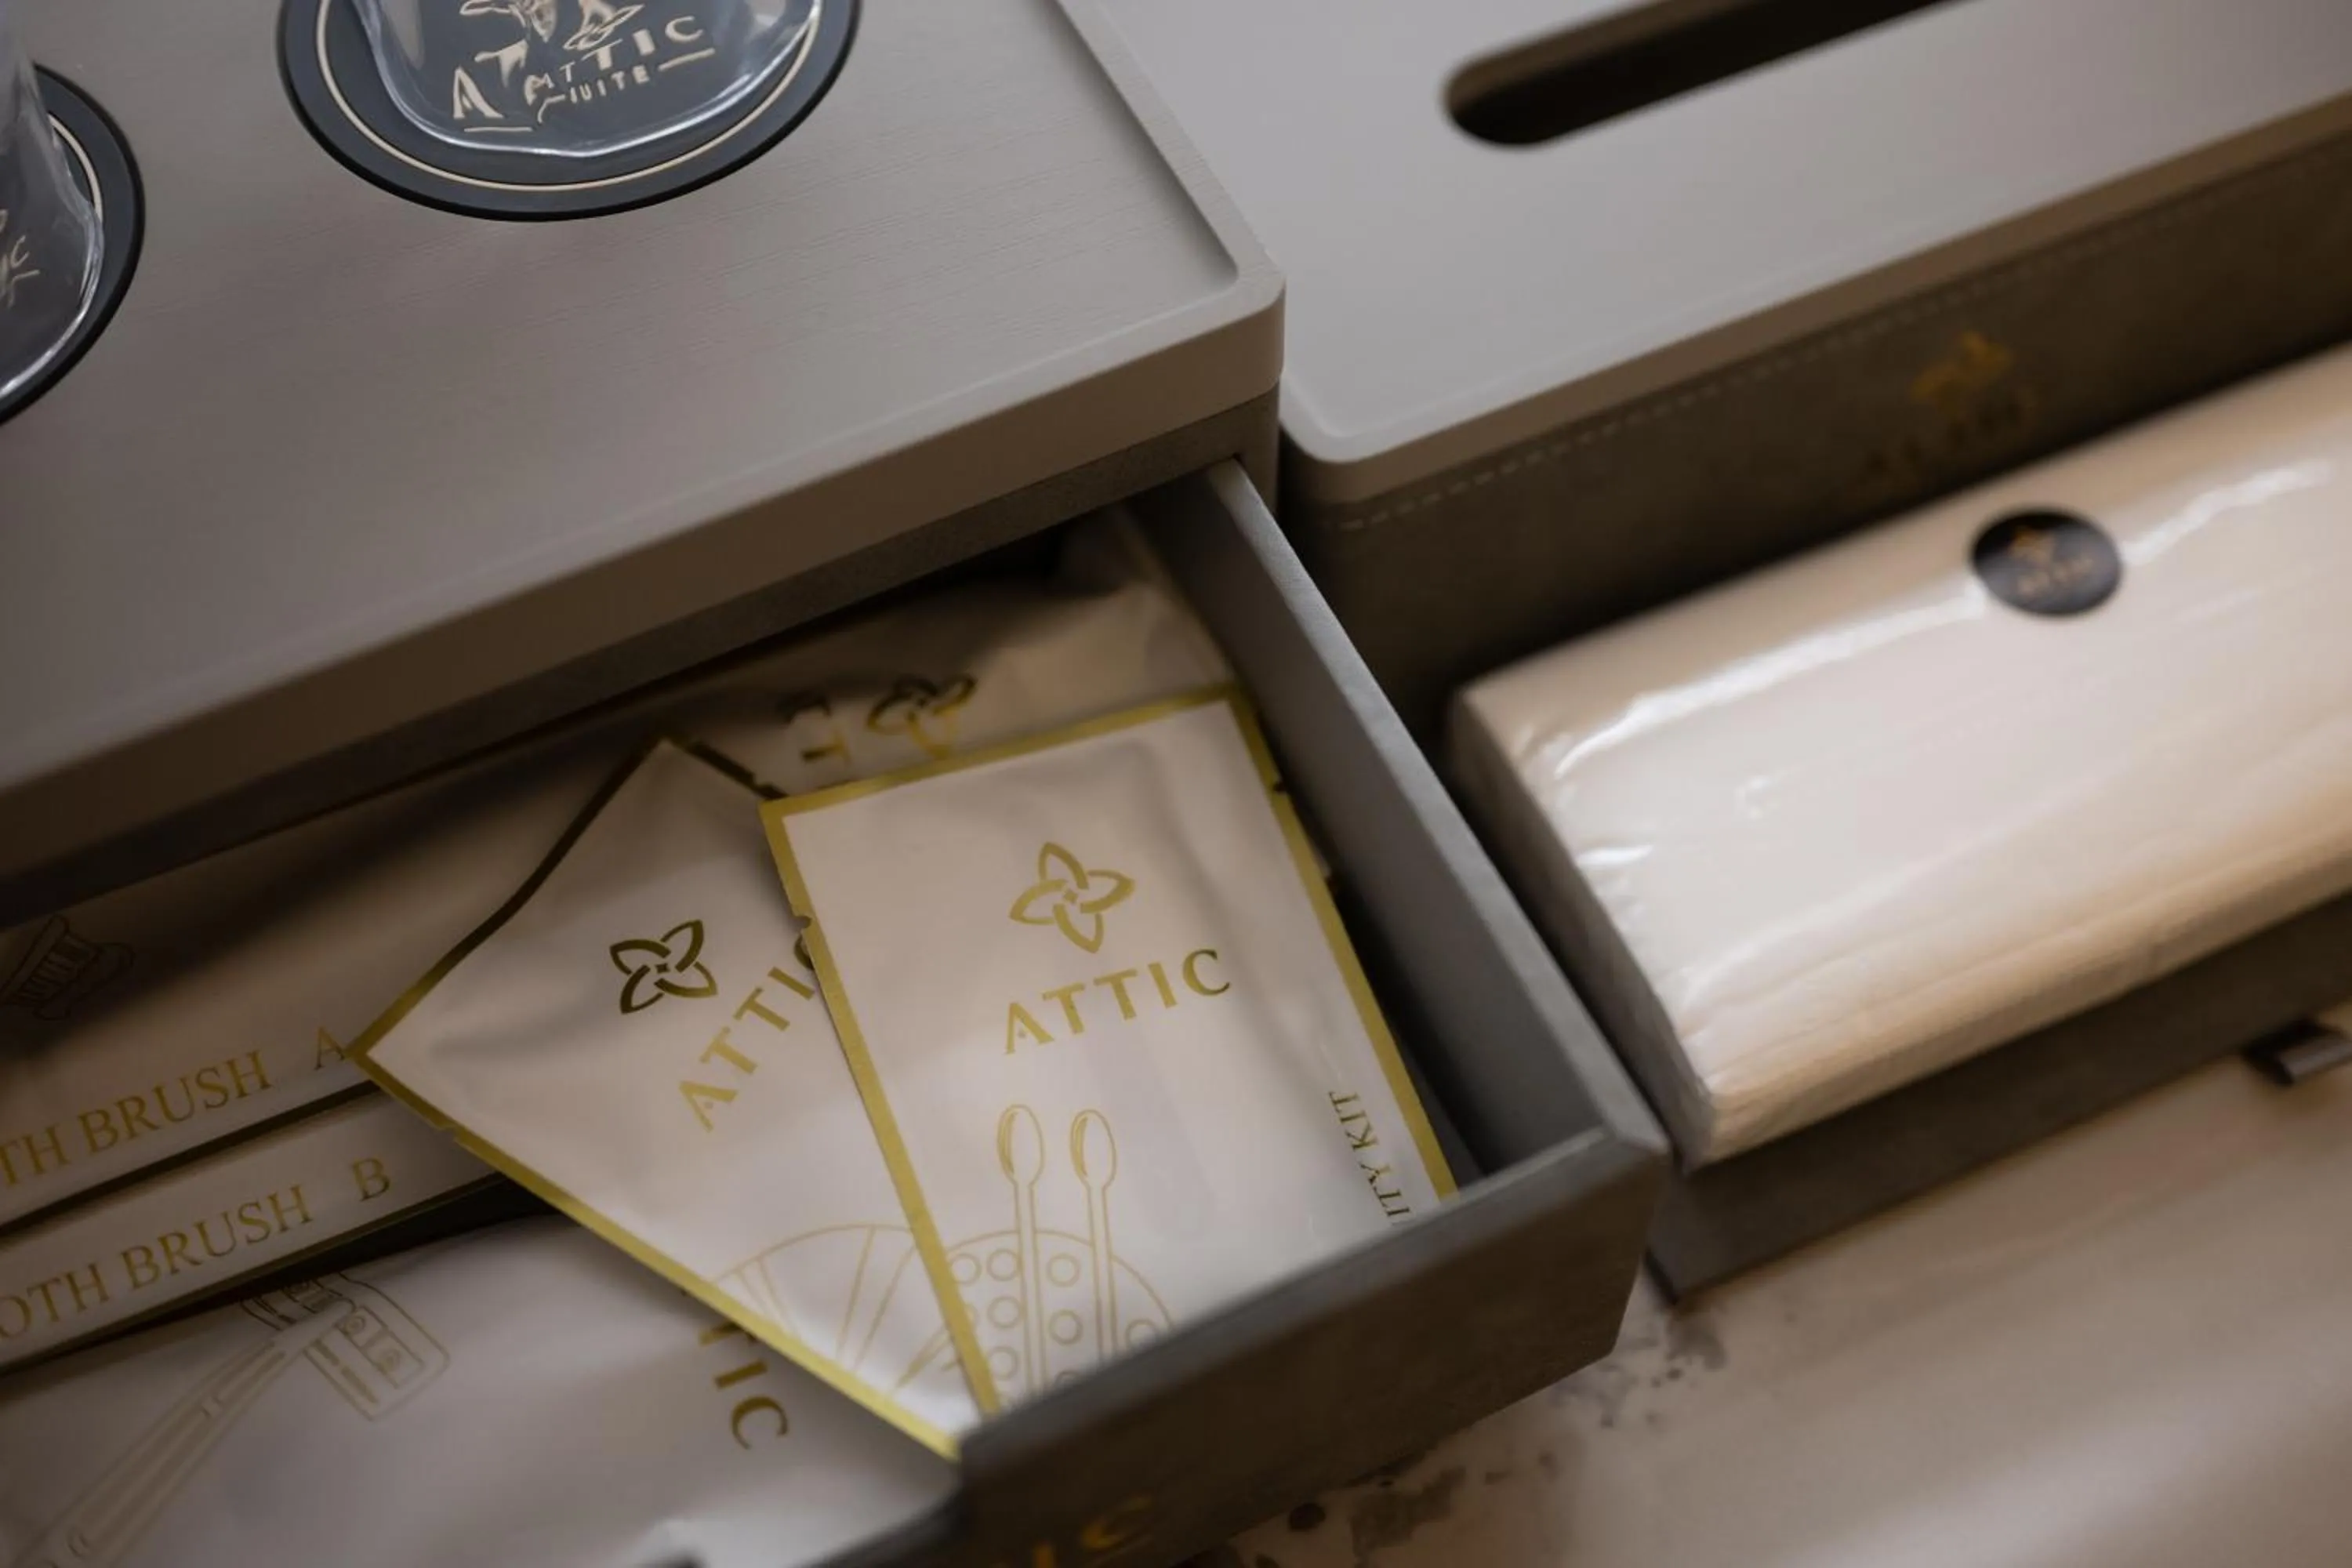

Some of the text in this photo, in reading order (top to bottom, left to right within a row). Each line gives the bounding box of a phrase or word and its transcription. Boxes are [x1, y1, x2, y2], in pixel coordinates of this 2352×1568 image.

[1004, 948, 1231, 1054] ATTIC
[76, 1049, 272, 1153] BRUSH
[314, 1025, 347, 1071] A
[120, 1184, 313, 1290] BRUSH
[350, 1156, 391, 1203] B
[1328, 1091, 1410, 1225] ITY KIT
